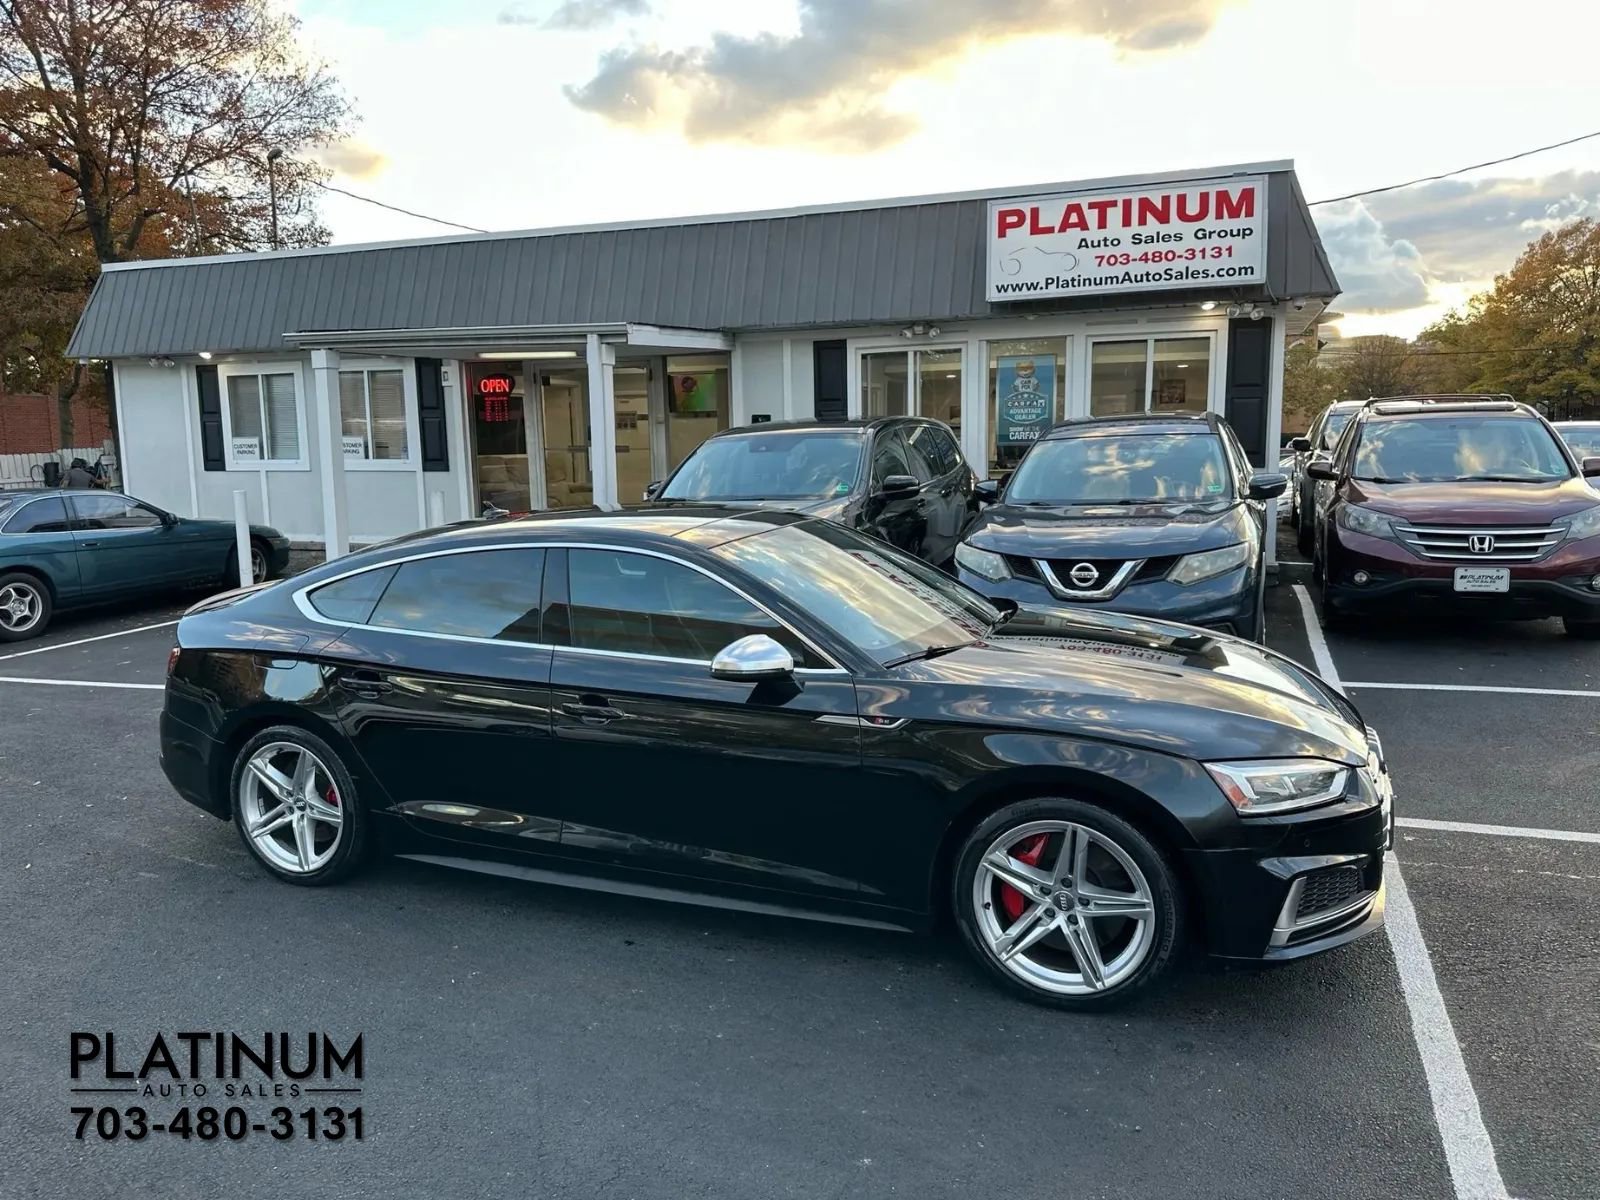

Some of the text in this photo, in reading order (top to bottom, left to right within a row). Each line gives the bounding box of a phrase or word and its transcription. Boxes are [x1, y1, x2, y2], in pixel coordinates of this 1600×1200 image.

[997, 187, 1256, 239] PLATINUM
[1077, 226, 1254, 250] Auto Sales Group
[1094, 245, 1233, 267] 703-480-3131
[995, 263, 1255, 294] www.PlatinumAutoSales.com
[480, 379, 509, 393] OPEN
[1009, 431, 1040, 440] CARFAX
